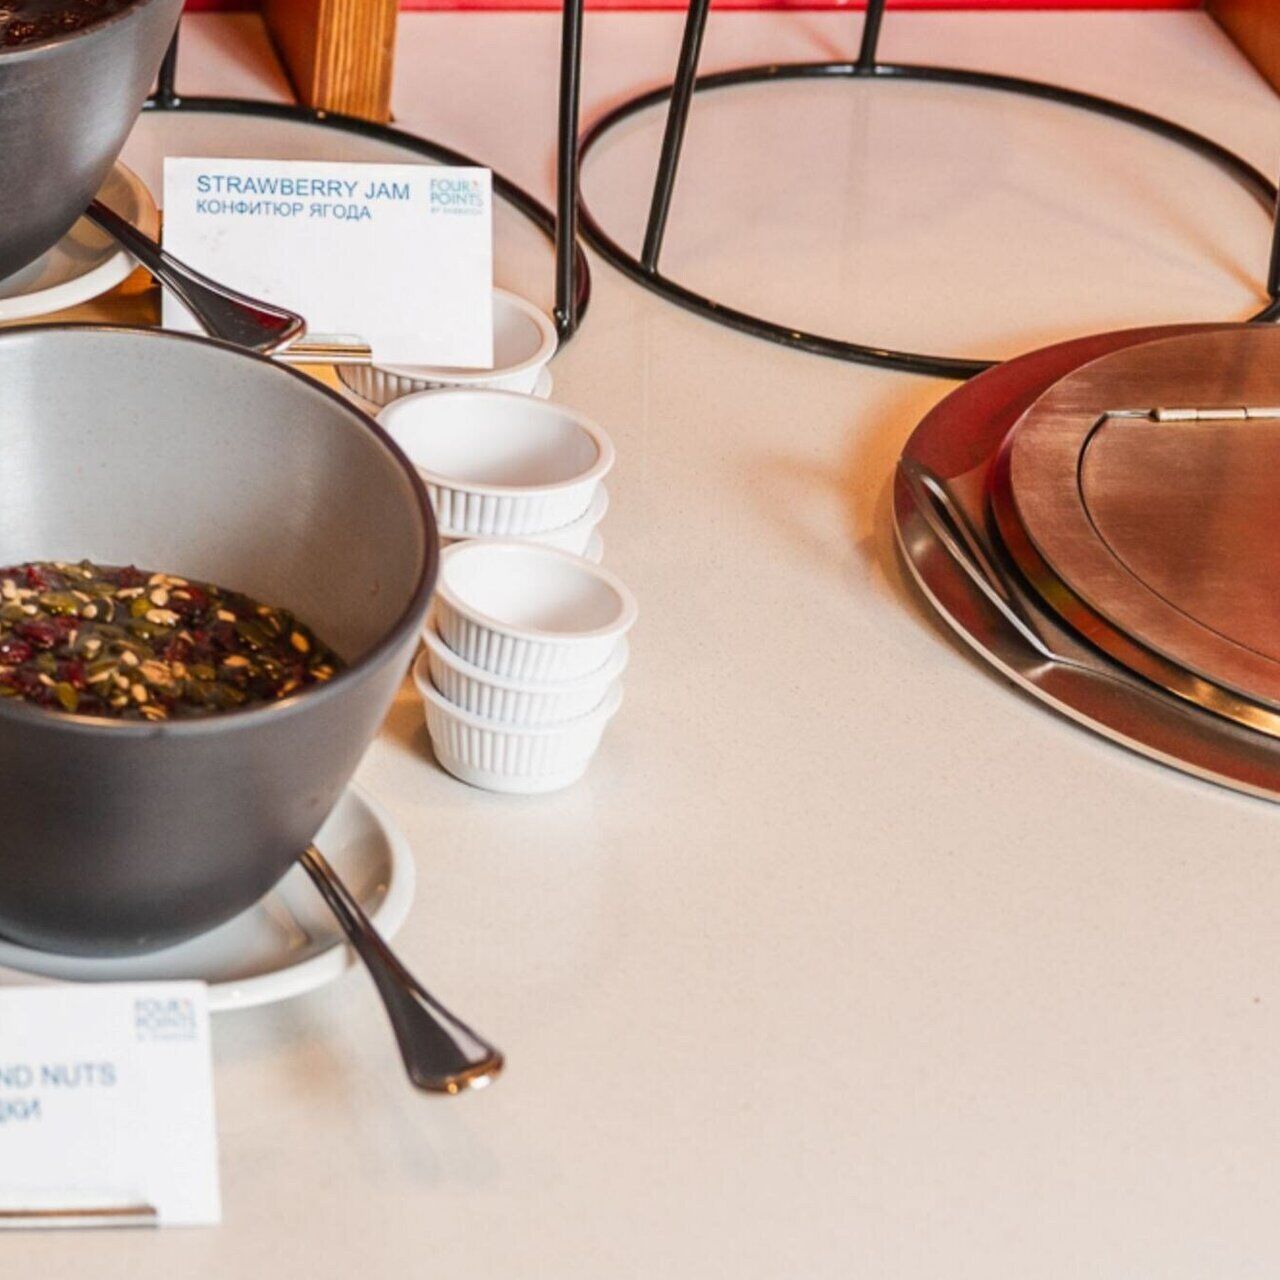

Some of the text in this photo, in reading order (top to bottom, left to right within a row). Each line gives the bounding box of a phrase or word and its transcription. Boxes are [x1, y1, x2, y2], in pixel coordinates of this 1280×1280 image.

[196, 175, 410, 200] STRAWBERRY JAM
[196, 199, 372, 220] КОНФИТЮР ЯГОДА
[42, 1062, 117, 1087] NUTS
